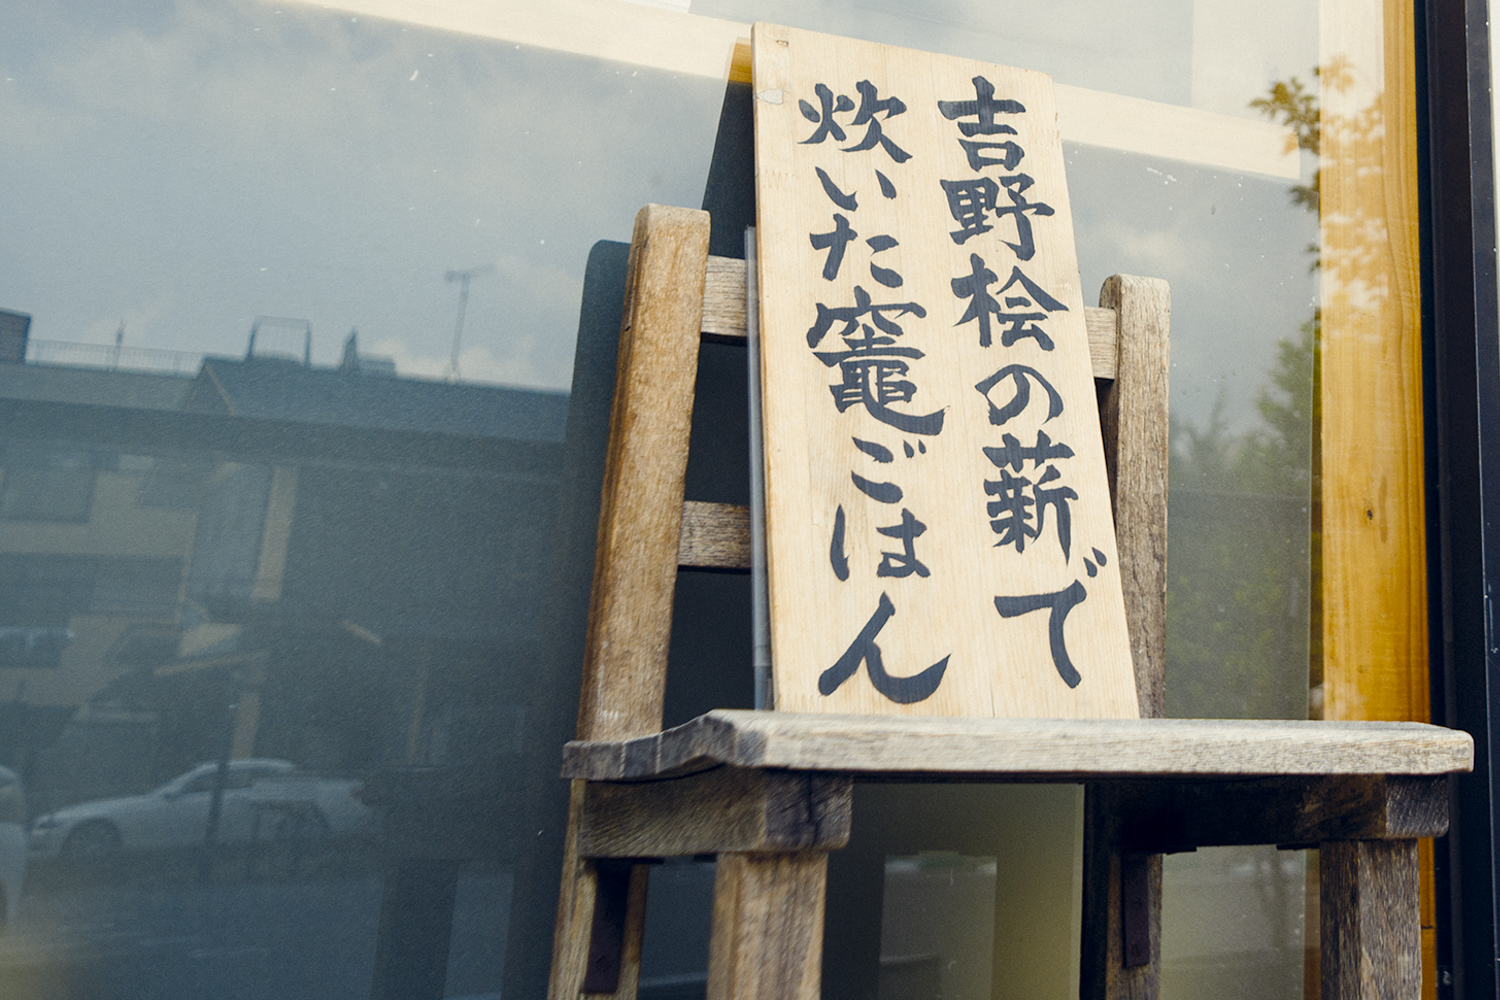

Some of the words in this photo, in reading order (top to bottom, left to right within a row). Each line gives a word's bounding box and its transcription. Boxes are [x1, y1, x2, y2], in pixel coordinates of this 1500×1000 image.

[938, 75, 1107, 690] 吉野桧の薪で
